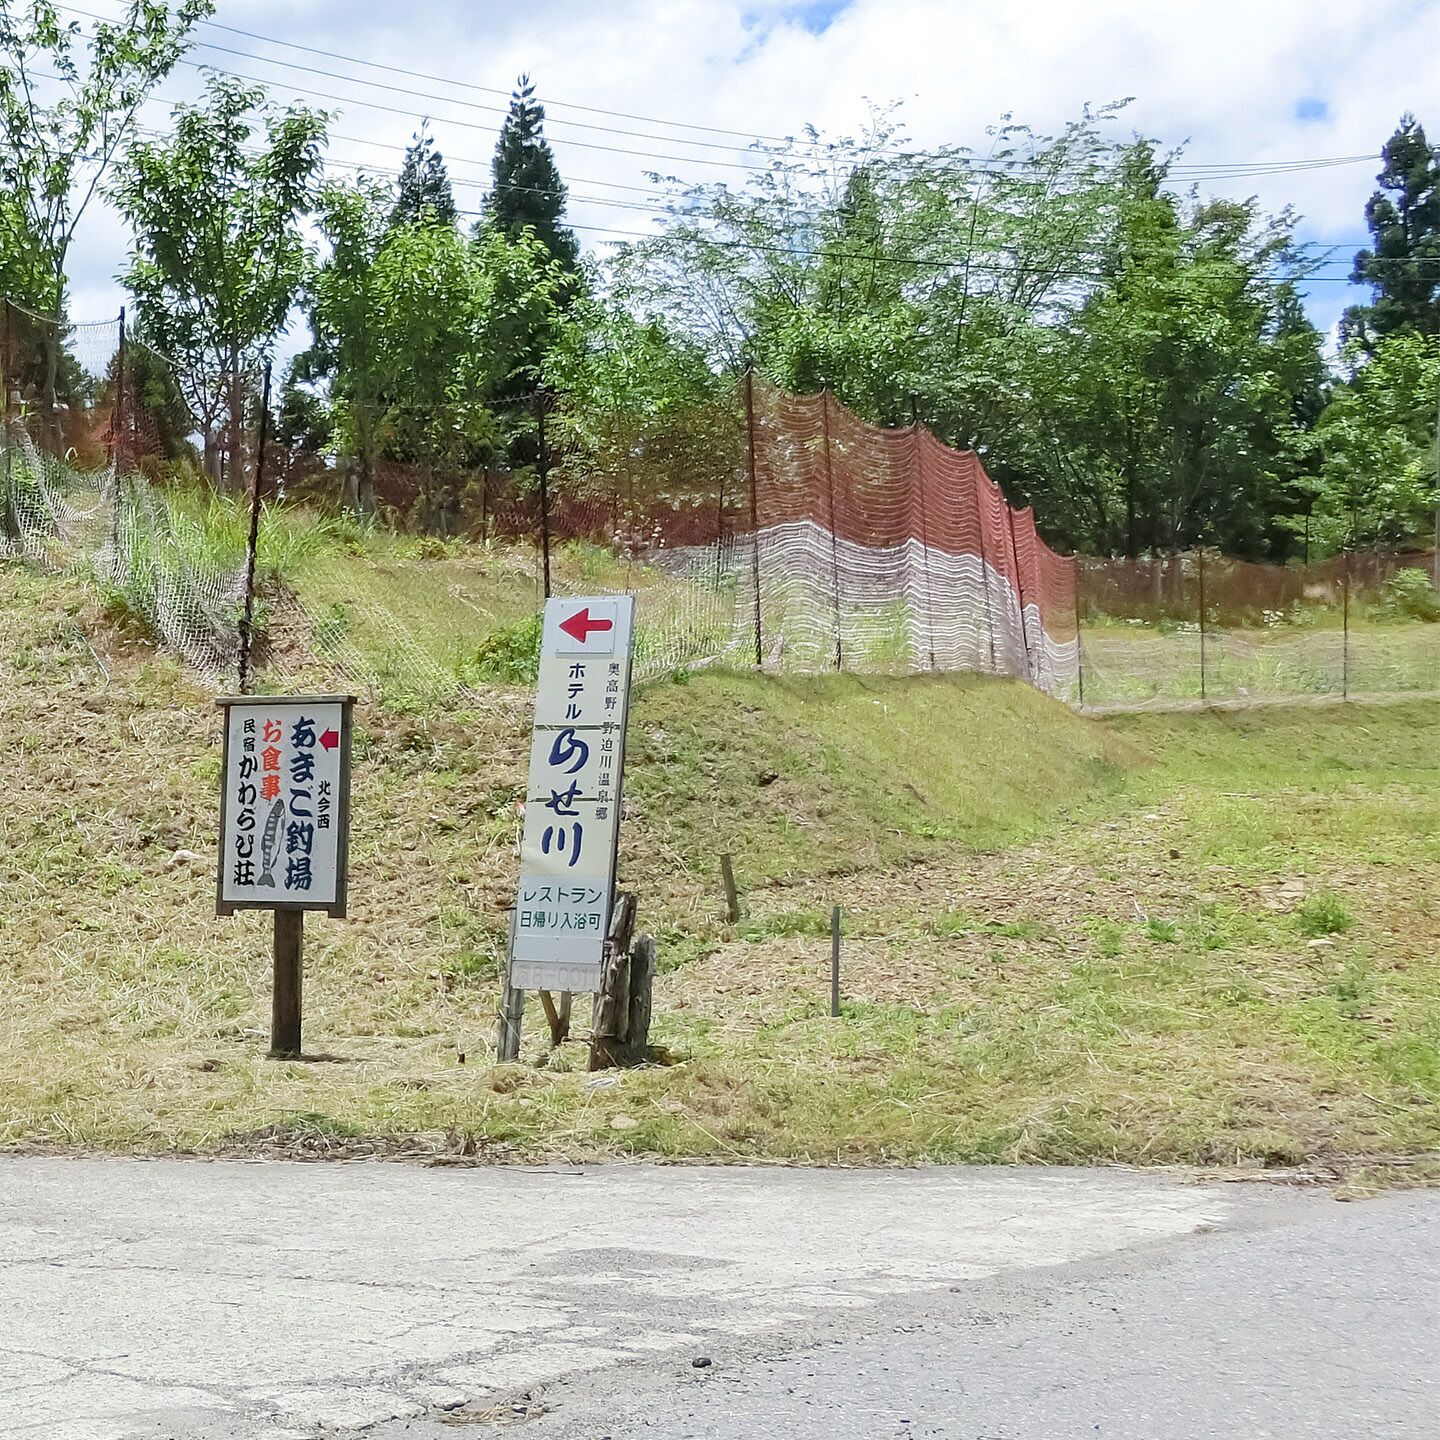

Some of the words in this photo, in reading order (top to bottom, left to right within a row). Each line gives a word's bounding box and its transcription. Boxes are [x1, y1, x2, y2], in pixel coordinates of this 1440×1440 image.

[259, 717, 282, 801] お食事
[283, 715, 317, 891] あまご釣場
[316, 779, 331, 829] 北今西
[520, 910, 601, 930] 日帰り入浴可
[523, 885, 603, 905] レストラン
